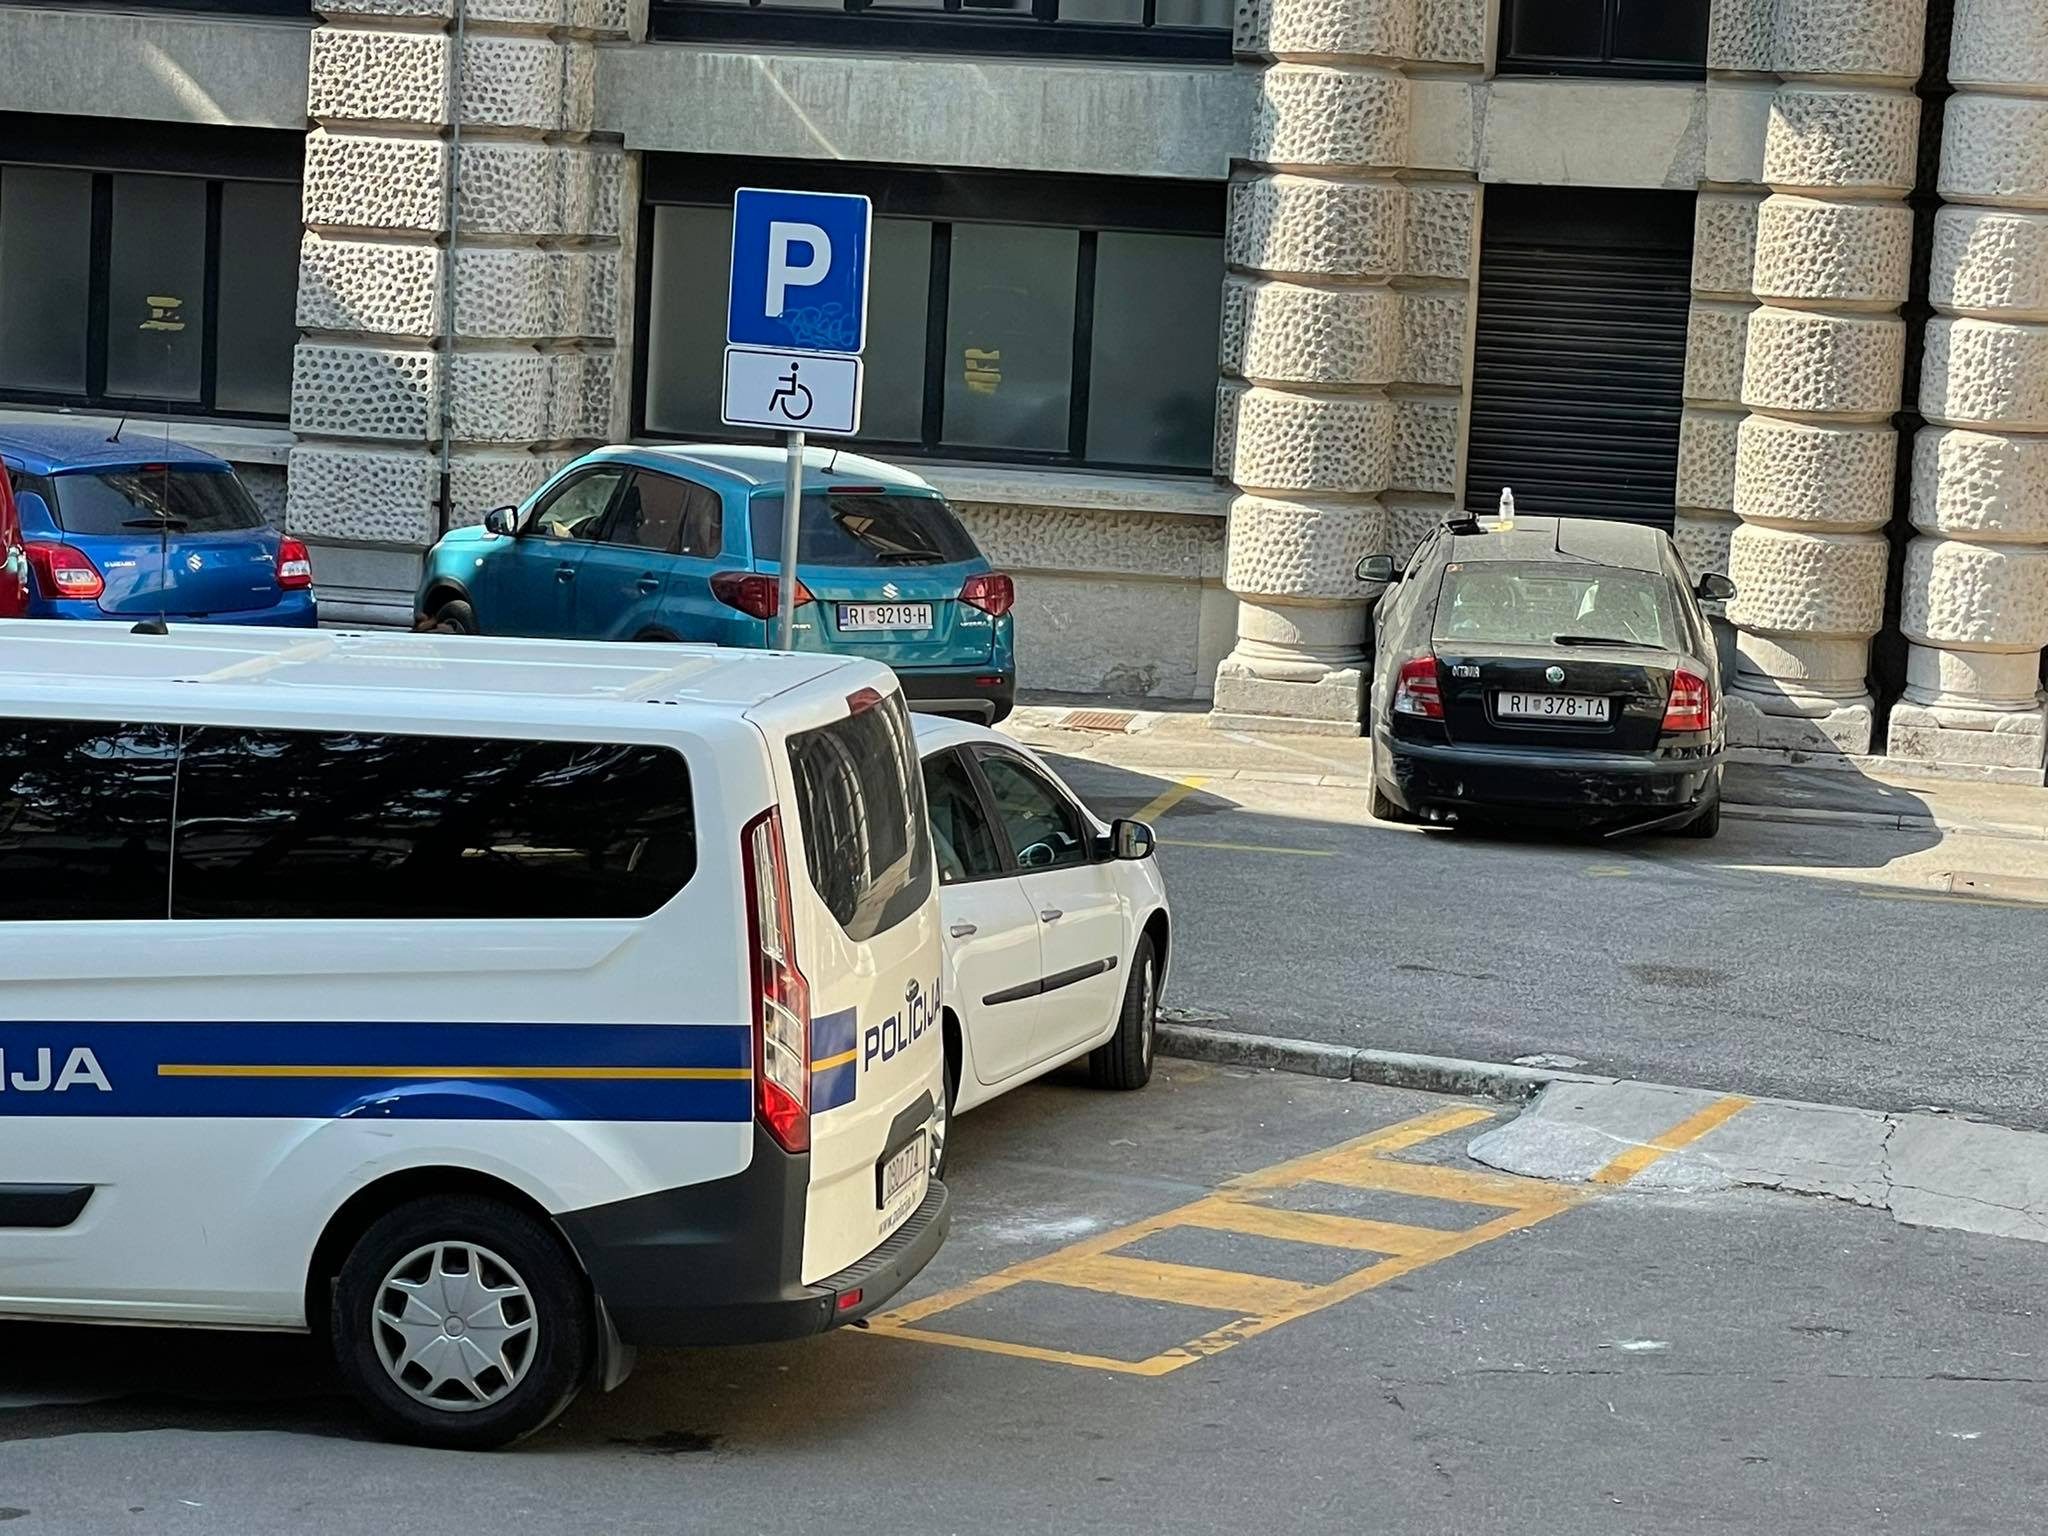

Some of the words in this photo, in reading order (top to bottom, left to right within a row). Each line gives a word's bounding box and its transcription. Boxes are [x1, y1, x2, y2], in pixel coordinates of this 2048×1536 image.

[765, 221, 832, 318] P
[850, 607, 865, 624] RI
[877, 607, 927, 624] 9219-H
[1510, 695, 1528, 712] RI
[1544, 696, 1605, 717] 378-TA
[864, 977, 941, 1073] POLICIJA
